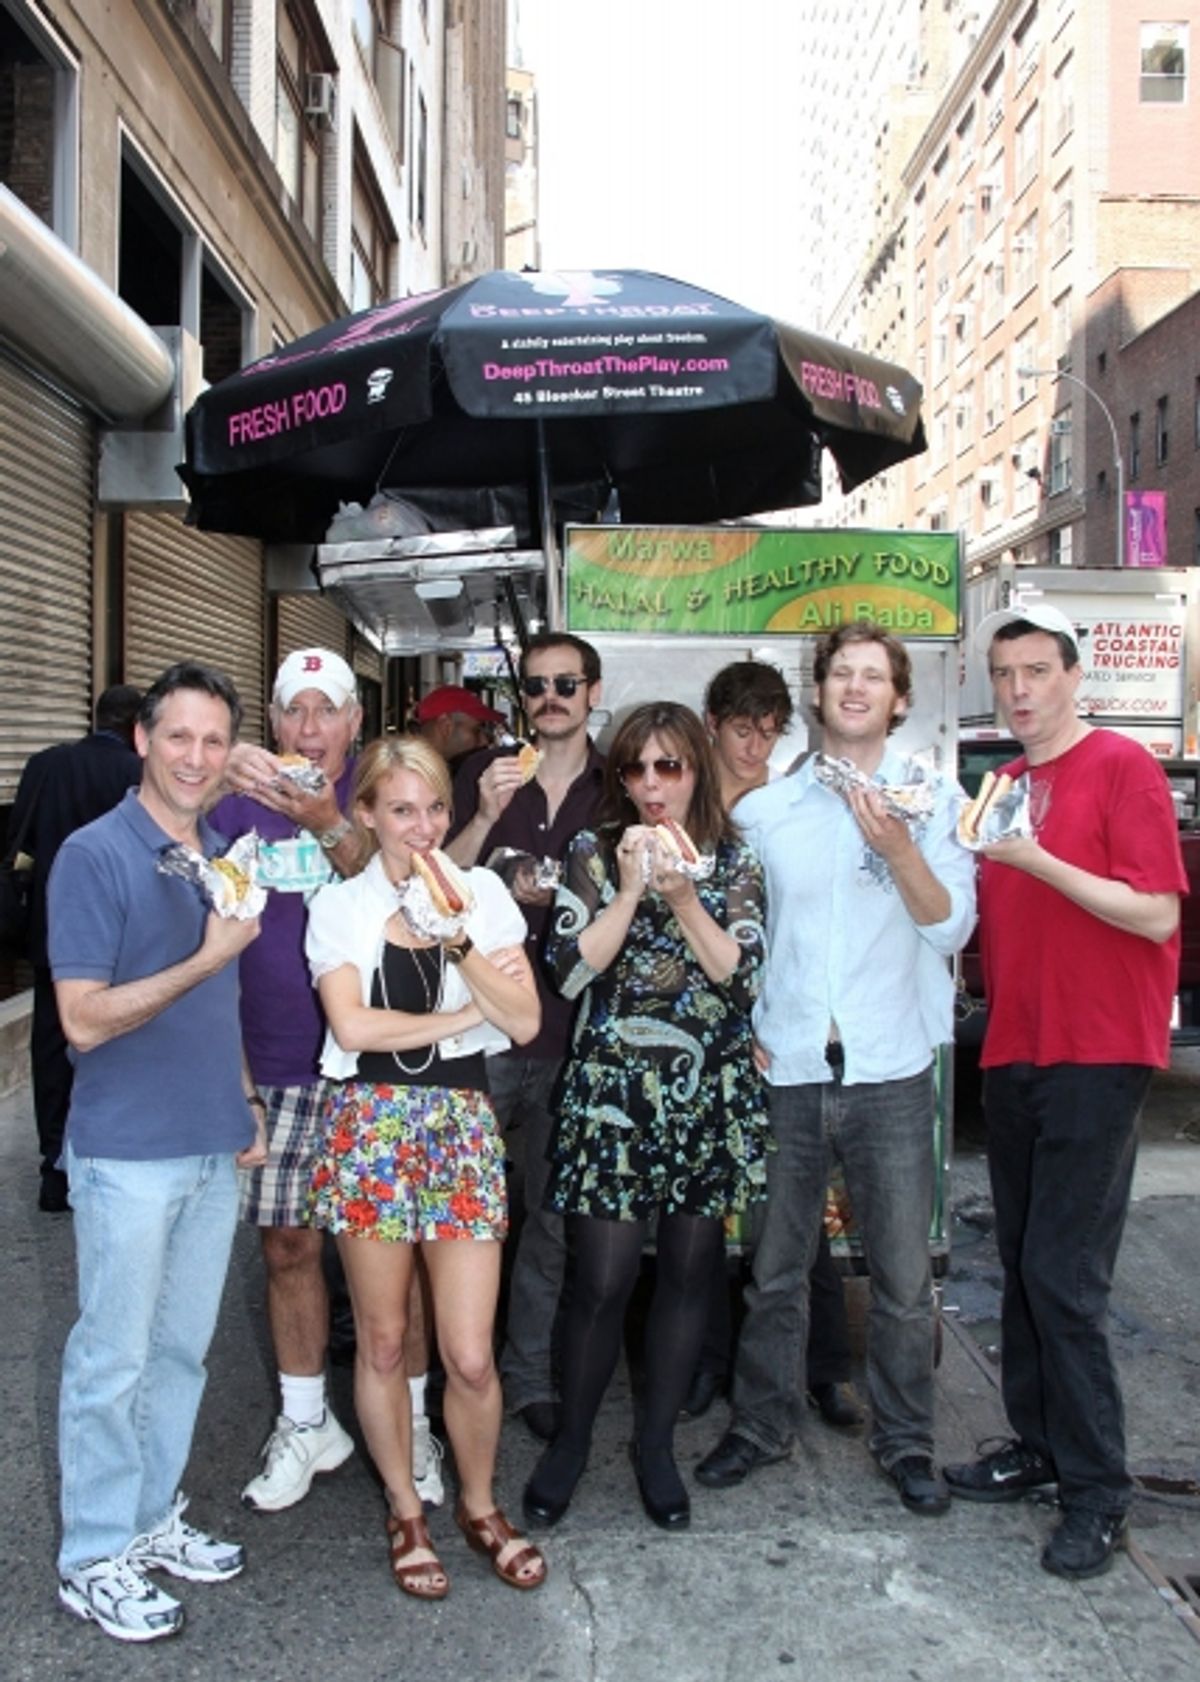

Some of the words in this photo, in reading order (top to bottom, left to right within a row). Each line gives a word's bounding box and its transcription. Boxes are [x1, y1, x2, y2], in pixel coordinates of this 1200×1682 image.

[483, 355, 729, 382] DeepThroatThePlay.com
[648, 384, 705, 397] Theatre
[801, 361, 843, 401] FRESH
[844, 371, 882, 409] FOOD
[229, 397, 290, 447] FRESH
[293, 383, 347, 427] FOOD
[608, 532, 715, 562] Marwa
[574, 580, 671, 615] HALAL
[686, 588, 709, 613] &
[724, 551, 861, 602] HEALTHY
[873, 551, 950, 586] FOOD
[799, 601, 842, 629] Ali
[854, 601, 934, 628] Baba
[1092, 622, 1182, 638] ATLANTIC
[1094, 638, 1179, 653] COASTAL
[302, 655, 323, 672] B
[1092, 653, 1181, 668] TRUCKING
[1114, 672, 1157, 683] SERVICE
